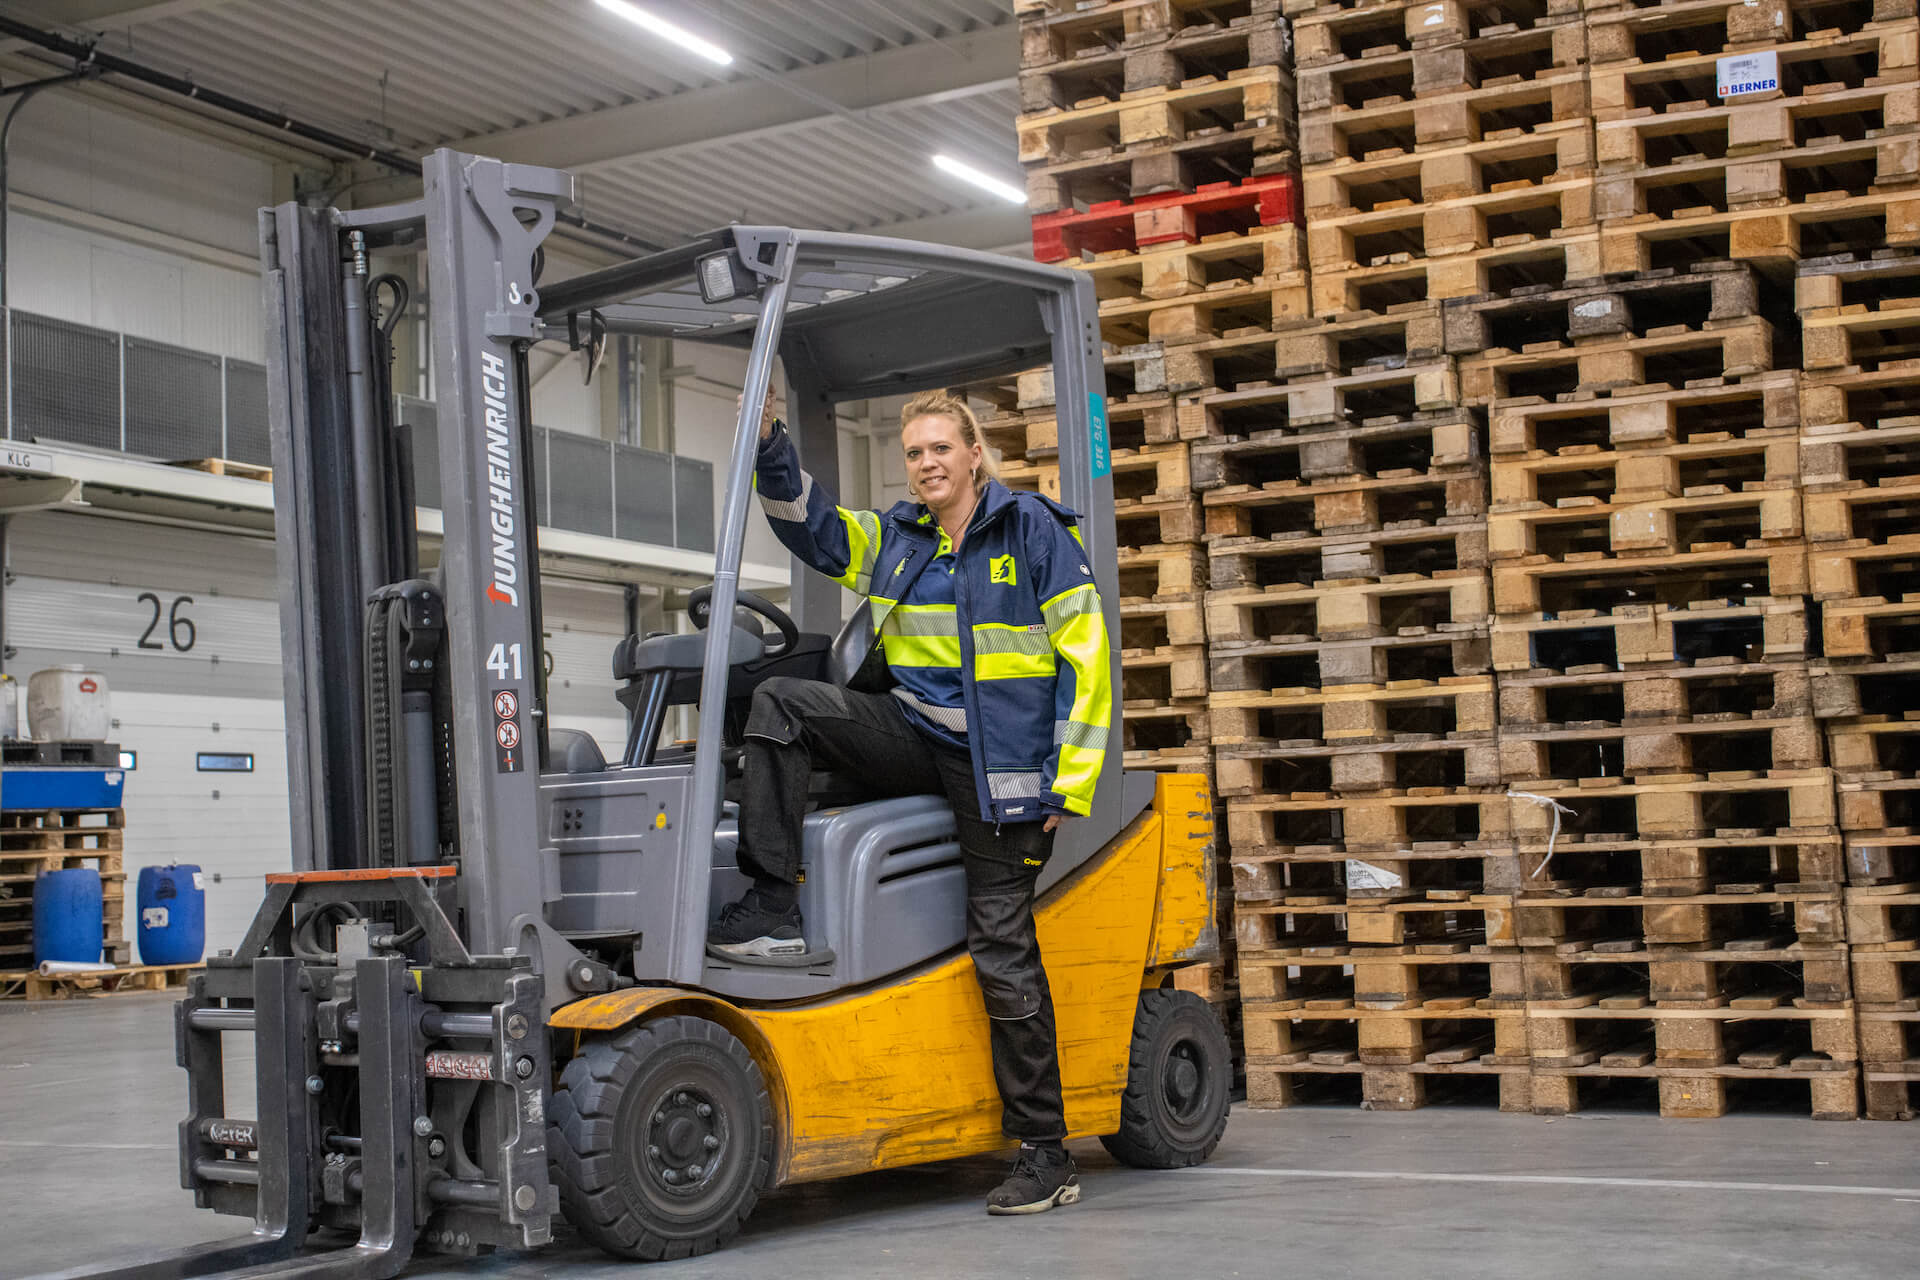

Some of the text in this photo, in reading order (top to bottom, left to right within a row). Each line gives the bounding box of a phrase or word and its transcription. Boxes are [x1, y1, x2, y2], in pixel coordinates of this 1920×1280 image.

[1730, 79, 1776, 94] BERNER
[7, 451, 31, 468] KLG
[482, 350, 518, 608] JUNGHEINRICH
[137, 591, 197, 653] 26
[486, 642, 522, 680] 41
